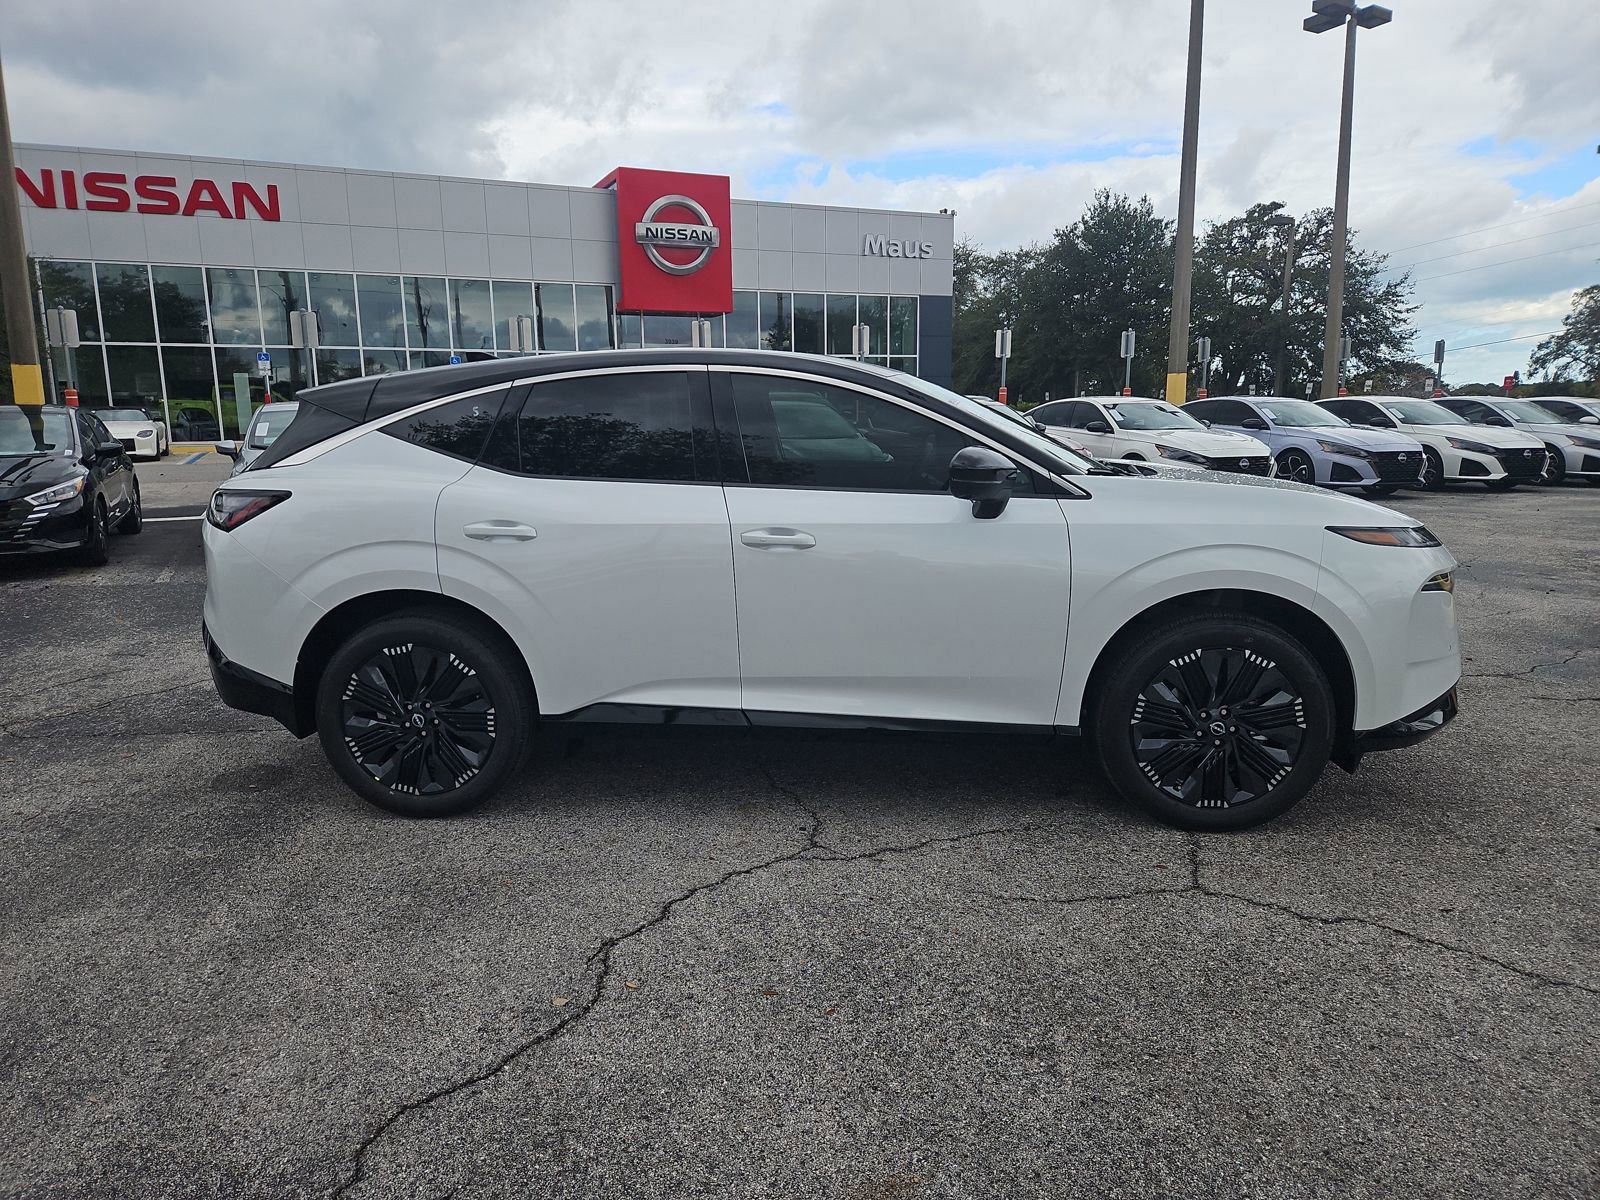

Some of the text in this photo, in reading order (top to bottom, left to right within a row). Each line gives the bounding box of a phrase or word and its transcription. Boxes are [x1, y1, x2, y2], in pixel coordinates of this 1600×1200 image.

[15, 167, 280, 222] NISSAN
[645, 226, 713, 243] NISSAN
[864, 233, 934, 259] Maus
